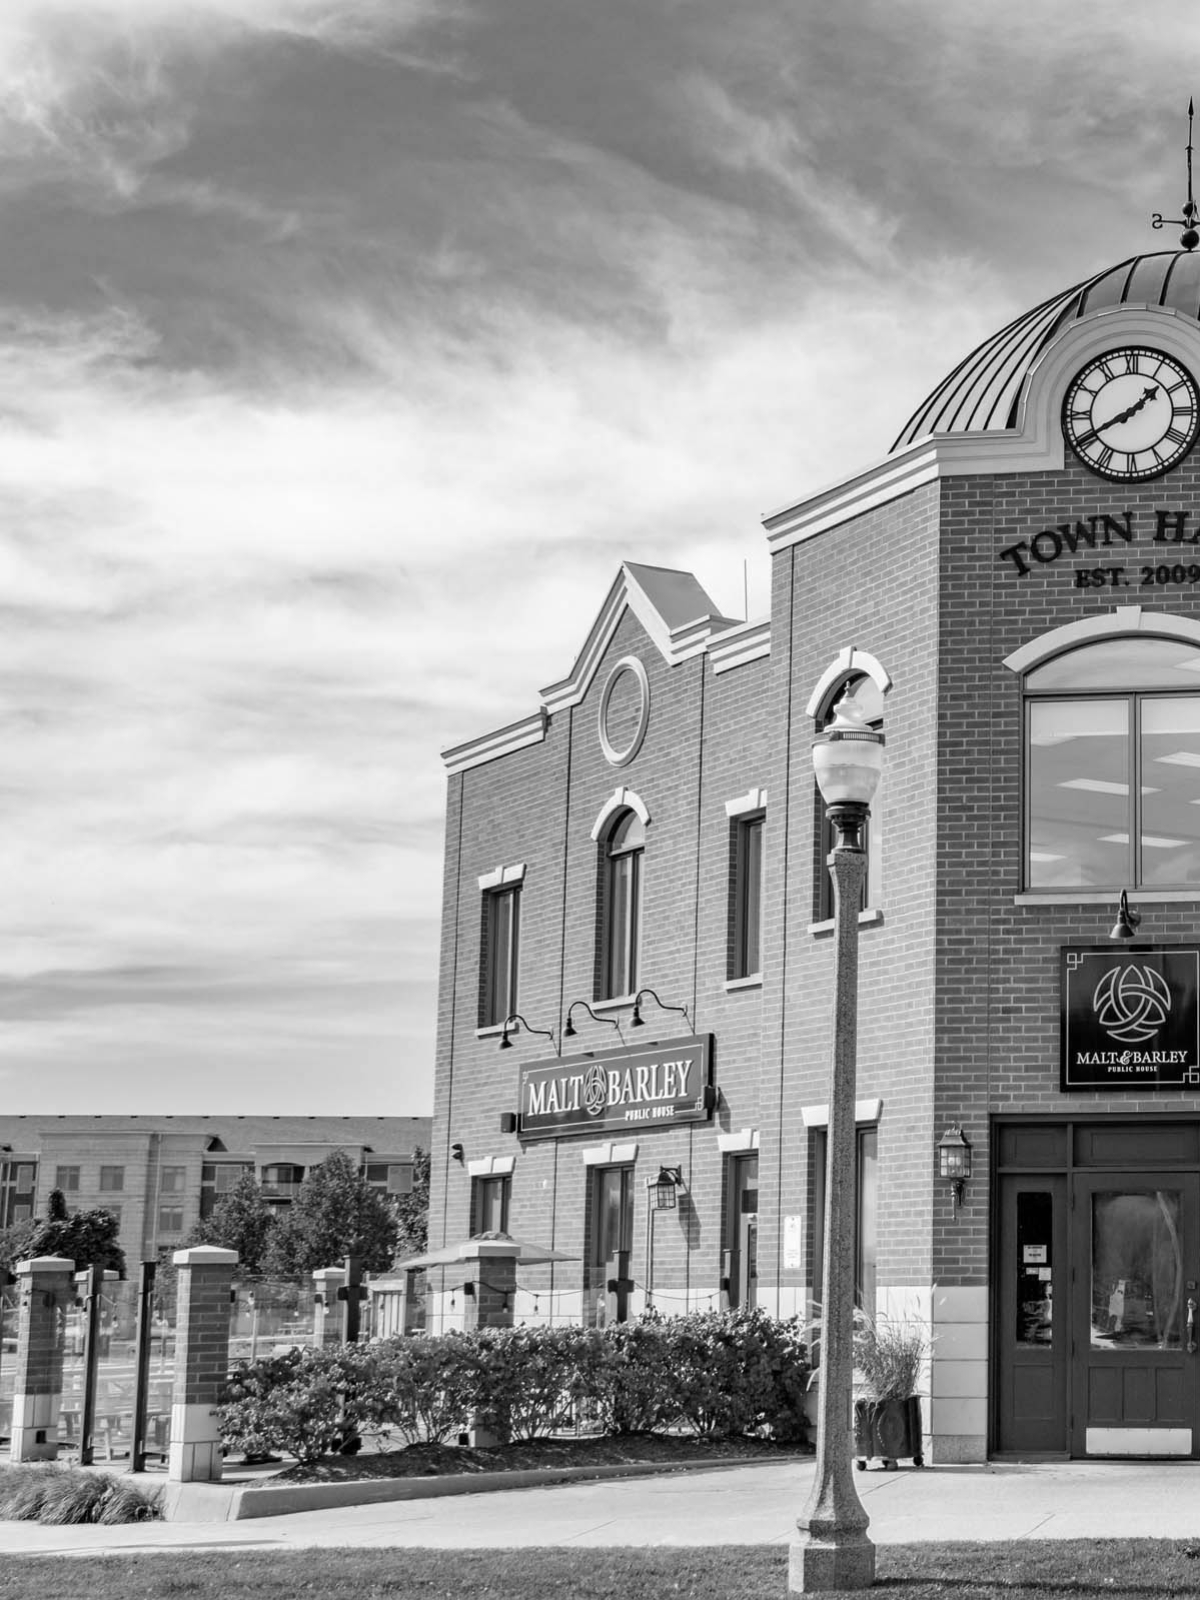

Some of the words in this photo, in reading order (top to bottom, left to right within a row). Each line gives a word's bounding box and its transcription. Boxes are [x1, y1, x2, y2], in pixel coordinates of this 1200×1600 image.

[1000, 511, 1133, 577] TOWN
[1075, 568, 1130, 588] EST.
[1142, 564, 1200, 585] 2009
[527, 1075, 584, 1116] MALT
[607, 1060, 692, 1106] BARLEY
[625, 1107, 650, 1121] PUBLIC
[652, 1105, 675, 1118] HOUSE
